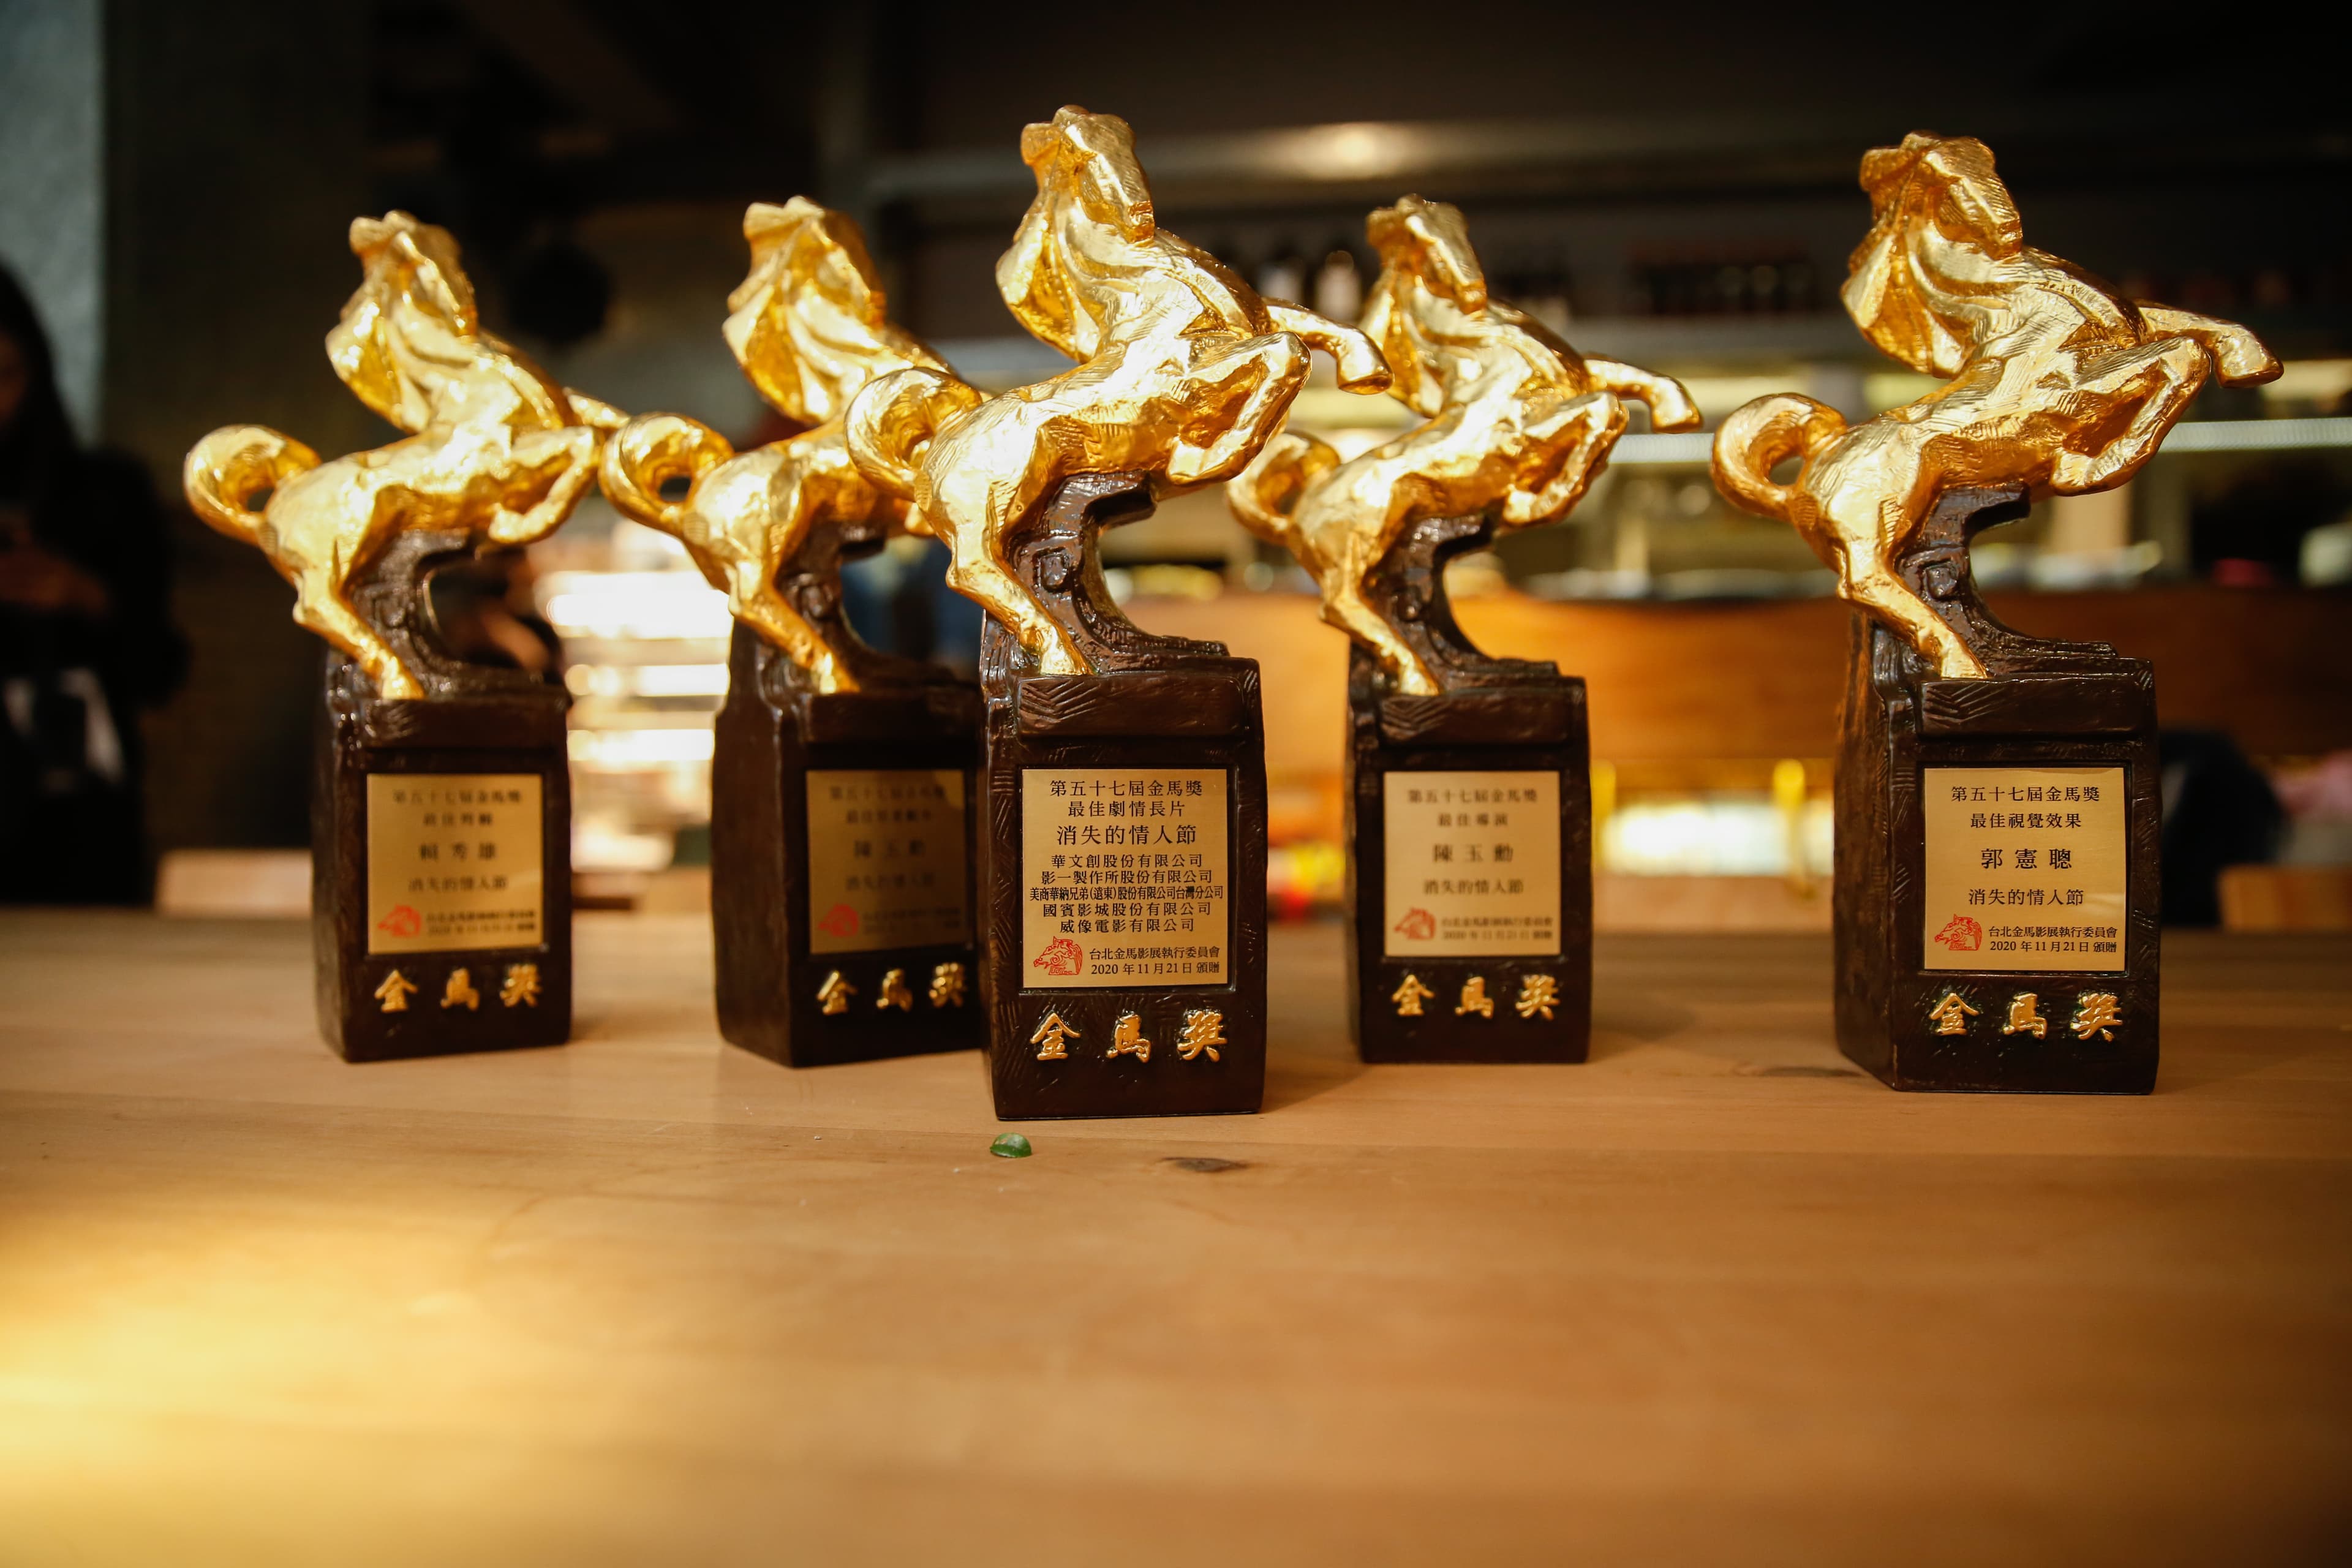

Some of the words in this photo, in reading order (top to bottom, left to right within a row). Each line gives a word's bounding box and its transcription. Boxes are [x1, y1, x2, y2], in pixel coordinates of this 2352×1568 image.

[1049, 779, 1202, 797] 第五十七屆金馬獎
[1951, 786, 2101, 803] 第五十七屆金馬獎
[1068, 799, 1185, 818] 最佳劇情長片
[1970, 812, 2081, 829] 最佳視覺效果
[1057, 824, 1196, 847] 消失的情人節
[1051, 854, 1203, 869] 華文創股份有限公司
[1981, 848, 2072, 870] 郭憲聰
[1041, 870, 1212, 884] 影一製作所股份有限公司
[1030, 886, 1223, 902] 美商華納兄弟(遠東)股份有限公司台灣分公司
[1968, 889, 2084, 906] 消失的情人節
[1042, 902, 1211, 918] 國賓影城股份有限公司
[1060, 918, 1194, 933] 威像電影有限公司
[1988, 926, 2118, 939] 台北金馬影展執行委員會
[1089, 946, 1220, 960] 台北金馬影展執行委員會
